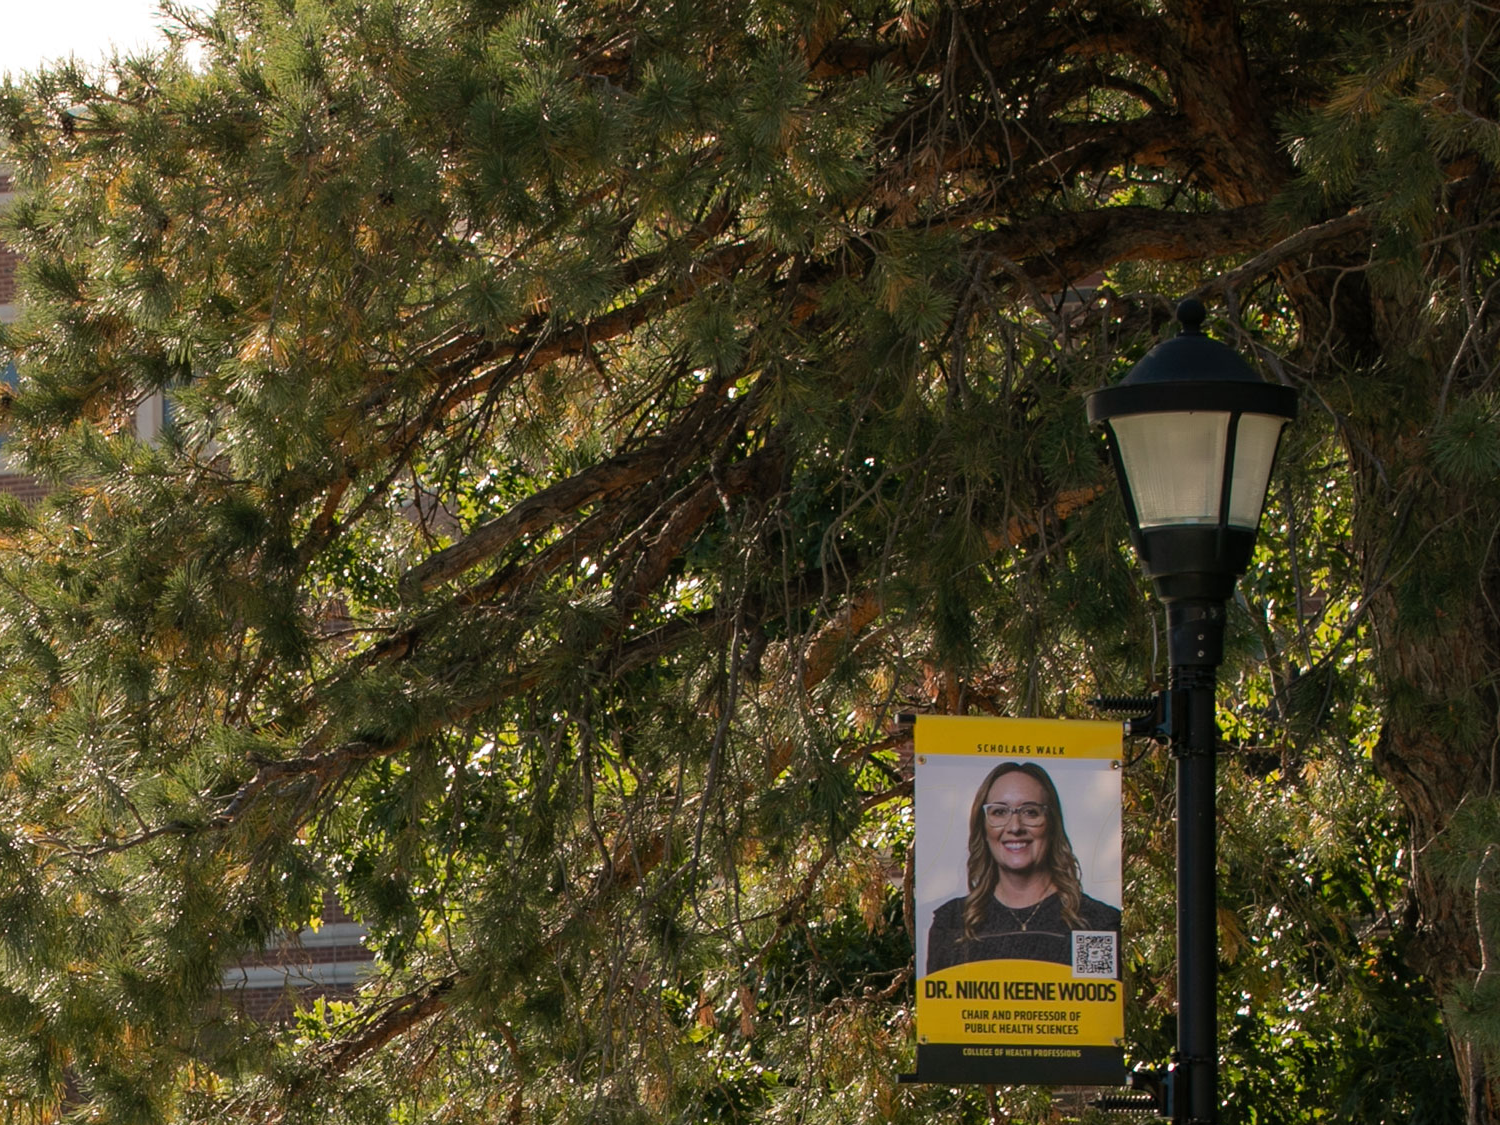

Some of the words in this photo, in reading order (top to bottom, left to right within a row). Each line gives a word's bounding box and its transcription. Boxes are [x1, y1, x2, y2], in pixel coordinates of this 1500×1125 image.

[977, 744, 1031, 754] SCHOLARS
[1036, 746, 1065, 755] WALK
[925, 981, 952, 999] DR.
[956, 981, 999, 1000] NIKKI
[1004, 982, 1056, 1001] KEENE
[1058, 982, 1116, 1002] WOODS
[961, 1010, 989, 1020] CHAIR
[992, 1010, 1011, 1020] AND
[1014, 1011, 1067, 1021] PROFESSOR
[1069, 1011, 1081, 1021] OF
[964, 1023, 996, 1033] PUBLIC
[999, 1024, 1033, 1034] HEALTH
[1036, 1024, 1078, 1034] SCIENCES
[963, 1048, 992, 1056] COLLEGE
[994, 1048, 1004, 1056] OF
[1005, 1048, 1031, 1057] HEALTH
[1033, 1049, 1081, 1058] PROFESSIONS
